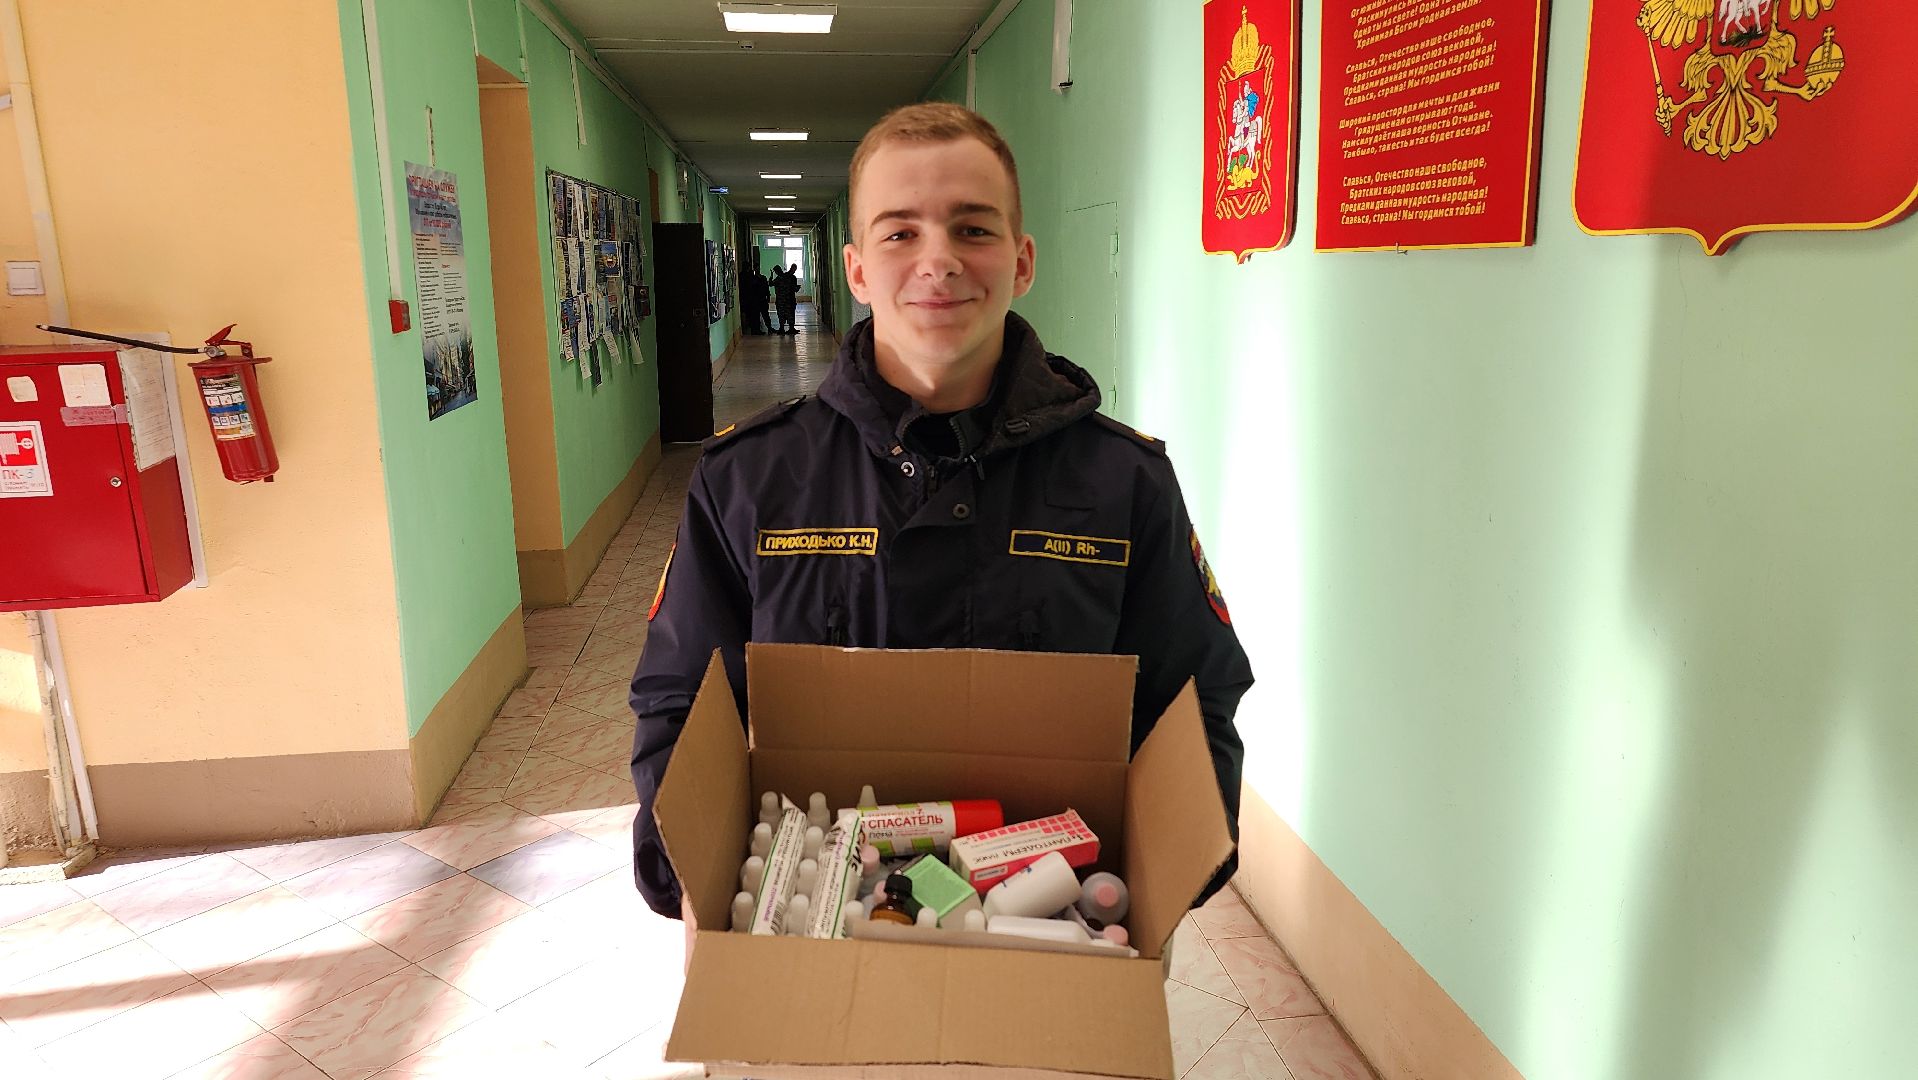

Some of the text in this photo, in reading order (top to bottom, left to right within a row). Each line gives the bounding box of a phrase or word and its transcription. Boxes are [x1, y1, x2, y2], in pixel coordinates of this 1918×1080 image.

[1353, 26, 1371, 40] Одна
[1372, 22, 1382, 32] ты
[1382, 18, 1392, 28] на
[1393, 5, 1418, 24] свете!
[1357, 29, 1394, 49] Хранимая
[1394, 20, 1418, 36] Богом
[1419, 7, 1450, 28] родная
[1358, 2, 1406, 26] Раскинулись
[1346, 18, 1495, 74] Славься, Отечество наше свободное,
[1353, 32, 1484, 83] Братских народов союз вековой,
[1344, 40, 1496, 96] Предками данная мудрость народная!
[1344, 54, 1494, 106] Славься, страна! Мы гордимся тобой!
[1339, 112, 1371, 129] Широкий
[1371, 106, 1402, 122] простор
[1402, 103, 1418, 115] для
[1418, 96, 1444, 109] мечты
[1451, 89, 1469, 103] для
[1469, 82, 1500, 96] жизни
[1354, 101, 1477, 137] Грядущие нам открывают года.
[1342, 110, 1493, 149] Нам силу даёт наша верность Отчизне.
[1344, 150, 1357, 159] Так
[1356, 147, 1378, 155] было,
[1378, 143, 1392, 152] так
[1392, 140, 1409, 150] есть
[1415, 136, 1429, 145] так
[1430, 130, 1455, 143] будет
[1455, 120, 1491, 138] всегда!
[1342, 156, 1487, 187] Славься, Отечество наше свободное,
[1349, 171, 1477, 200] Братских народов союз вековой,
[1340, 186, 1489, 214] Предками данная мудрость народная!
[1341, 201, 1486, 225] Славься, страна! Мы гордимся тобой!
[765, 534, 873, 549] ПРИХОДЬКО К.Н.
[1044, 538, 1100, 555] A(II) Rh-
[868, 815, 943, 829] СПАСАТЕЛЬ
